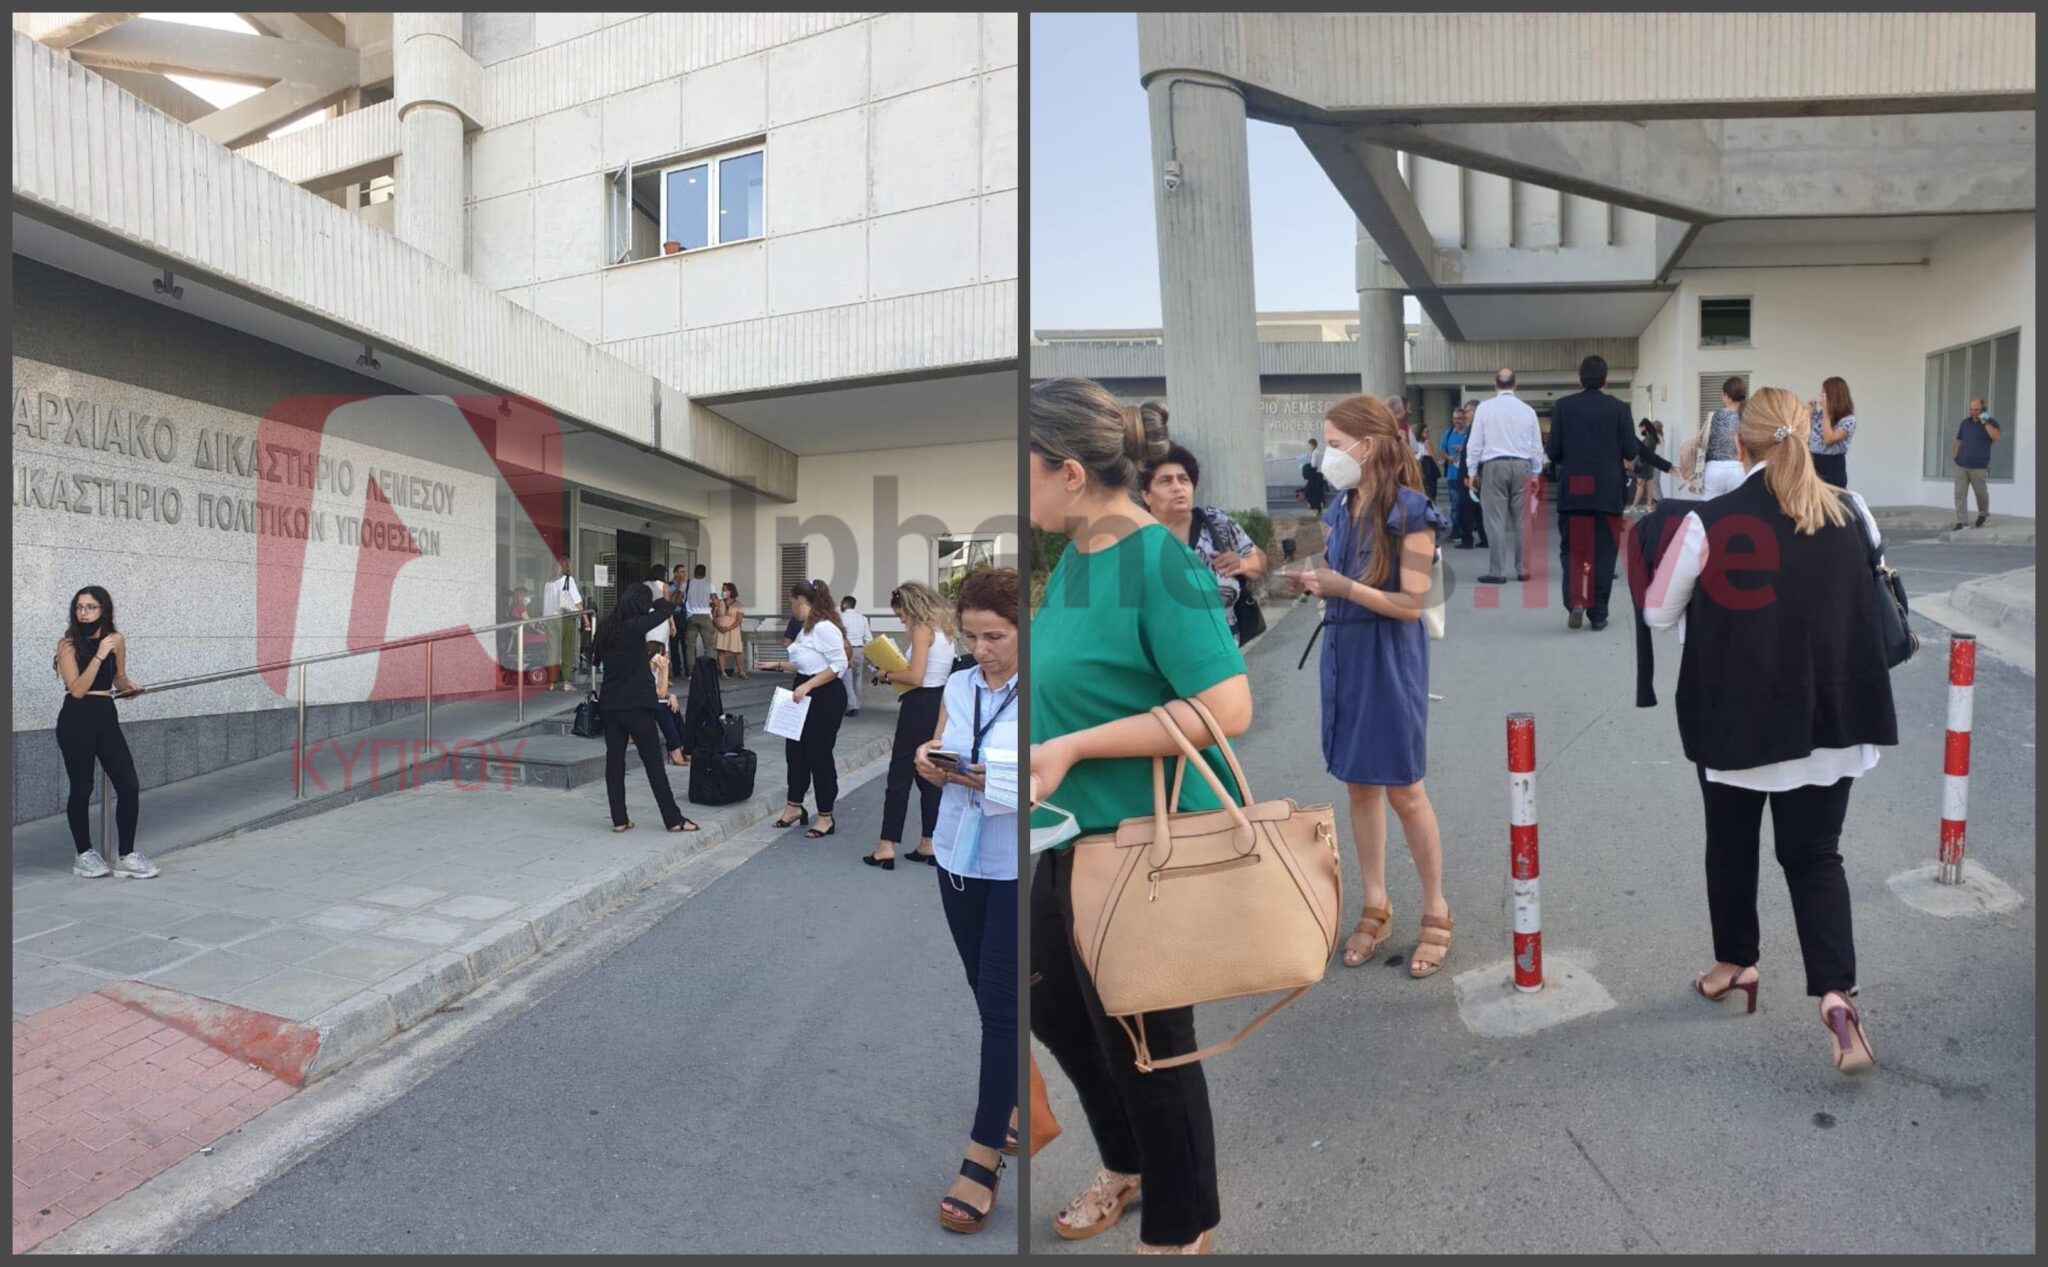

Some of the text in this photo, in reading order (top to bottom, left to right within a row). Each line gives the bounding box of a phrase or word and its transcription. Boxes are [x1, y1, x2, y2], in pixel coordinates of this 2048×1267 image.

[195, 428, 354, 496] ΔΙΚΑΣΤΗΡΙΟ
[366, 466, 456, 516] ΛΕΜΕΣΟΥ
[197, 493, 326, 542] ΠΟΛΙΤΙΚΩΝ
[335, 514, 440, 556] ΥΠΟΘΕΣΕΩΝ
